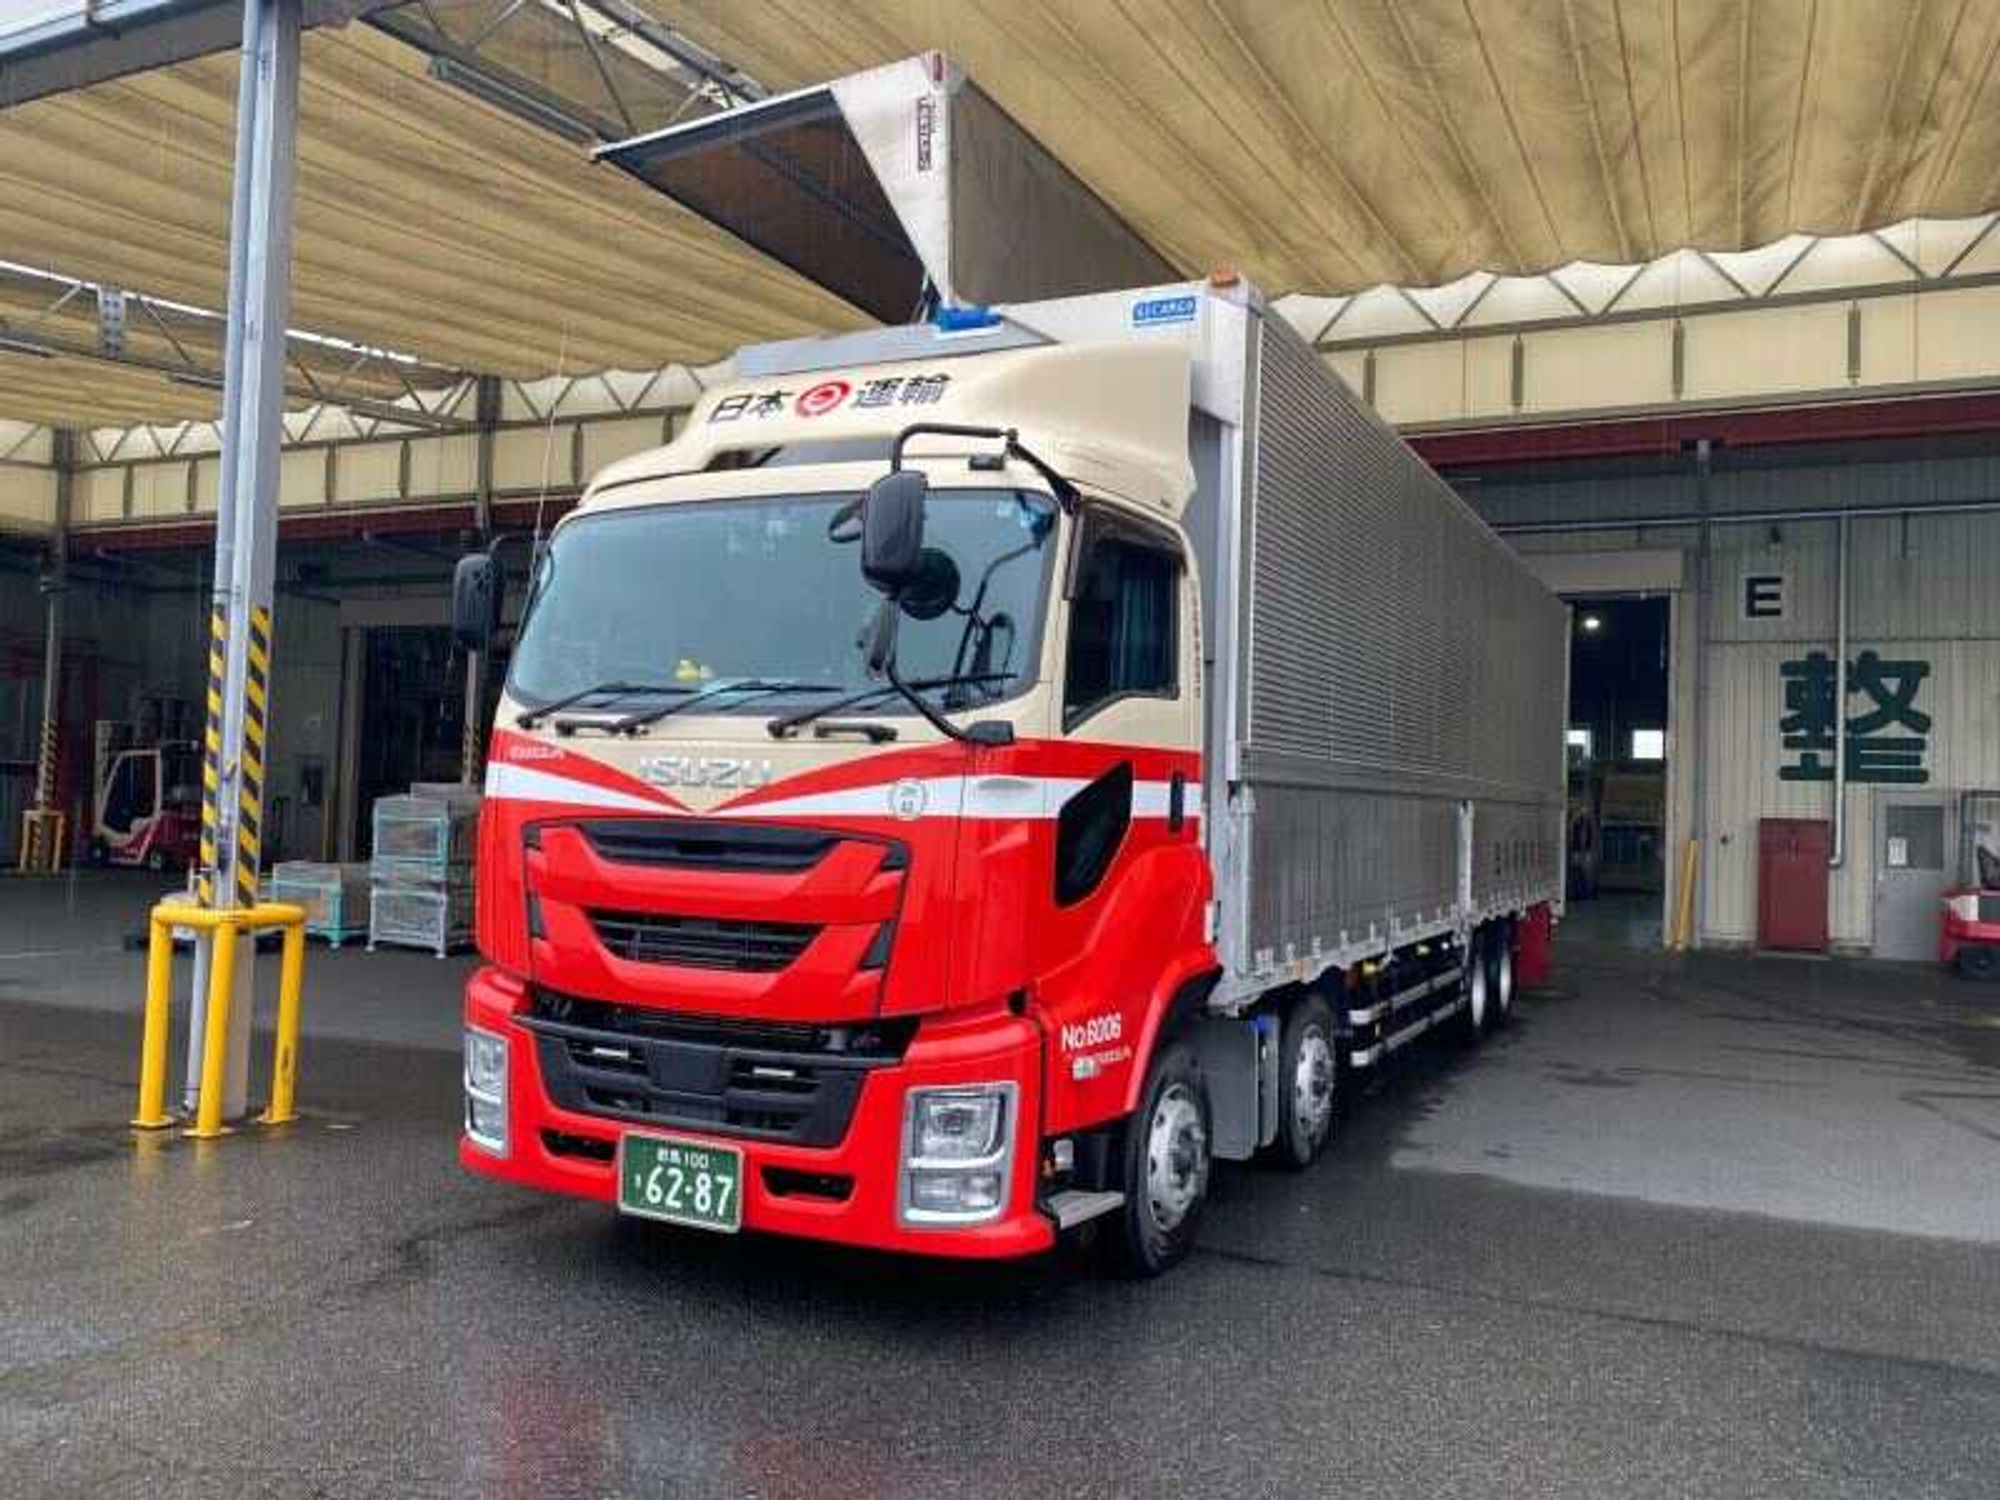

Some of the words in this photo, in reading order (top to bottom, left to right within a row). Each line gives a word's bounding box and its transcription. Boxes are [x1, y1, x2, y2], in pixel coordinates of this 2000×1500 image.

[708, 389, 794, 422] 日本
[854, 372, 951, 408] 運輸
[1745, 577, 1782, 618] E
[1780, 650, 1931, 783] 整
[639, 756, 773, 786] ISUZU
